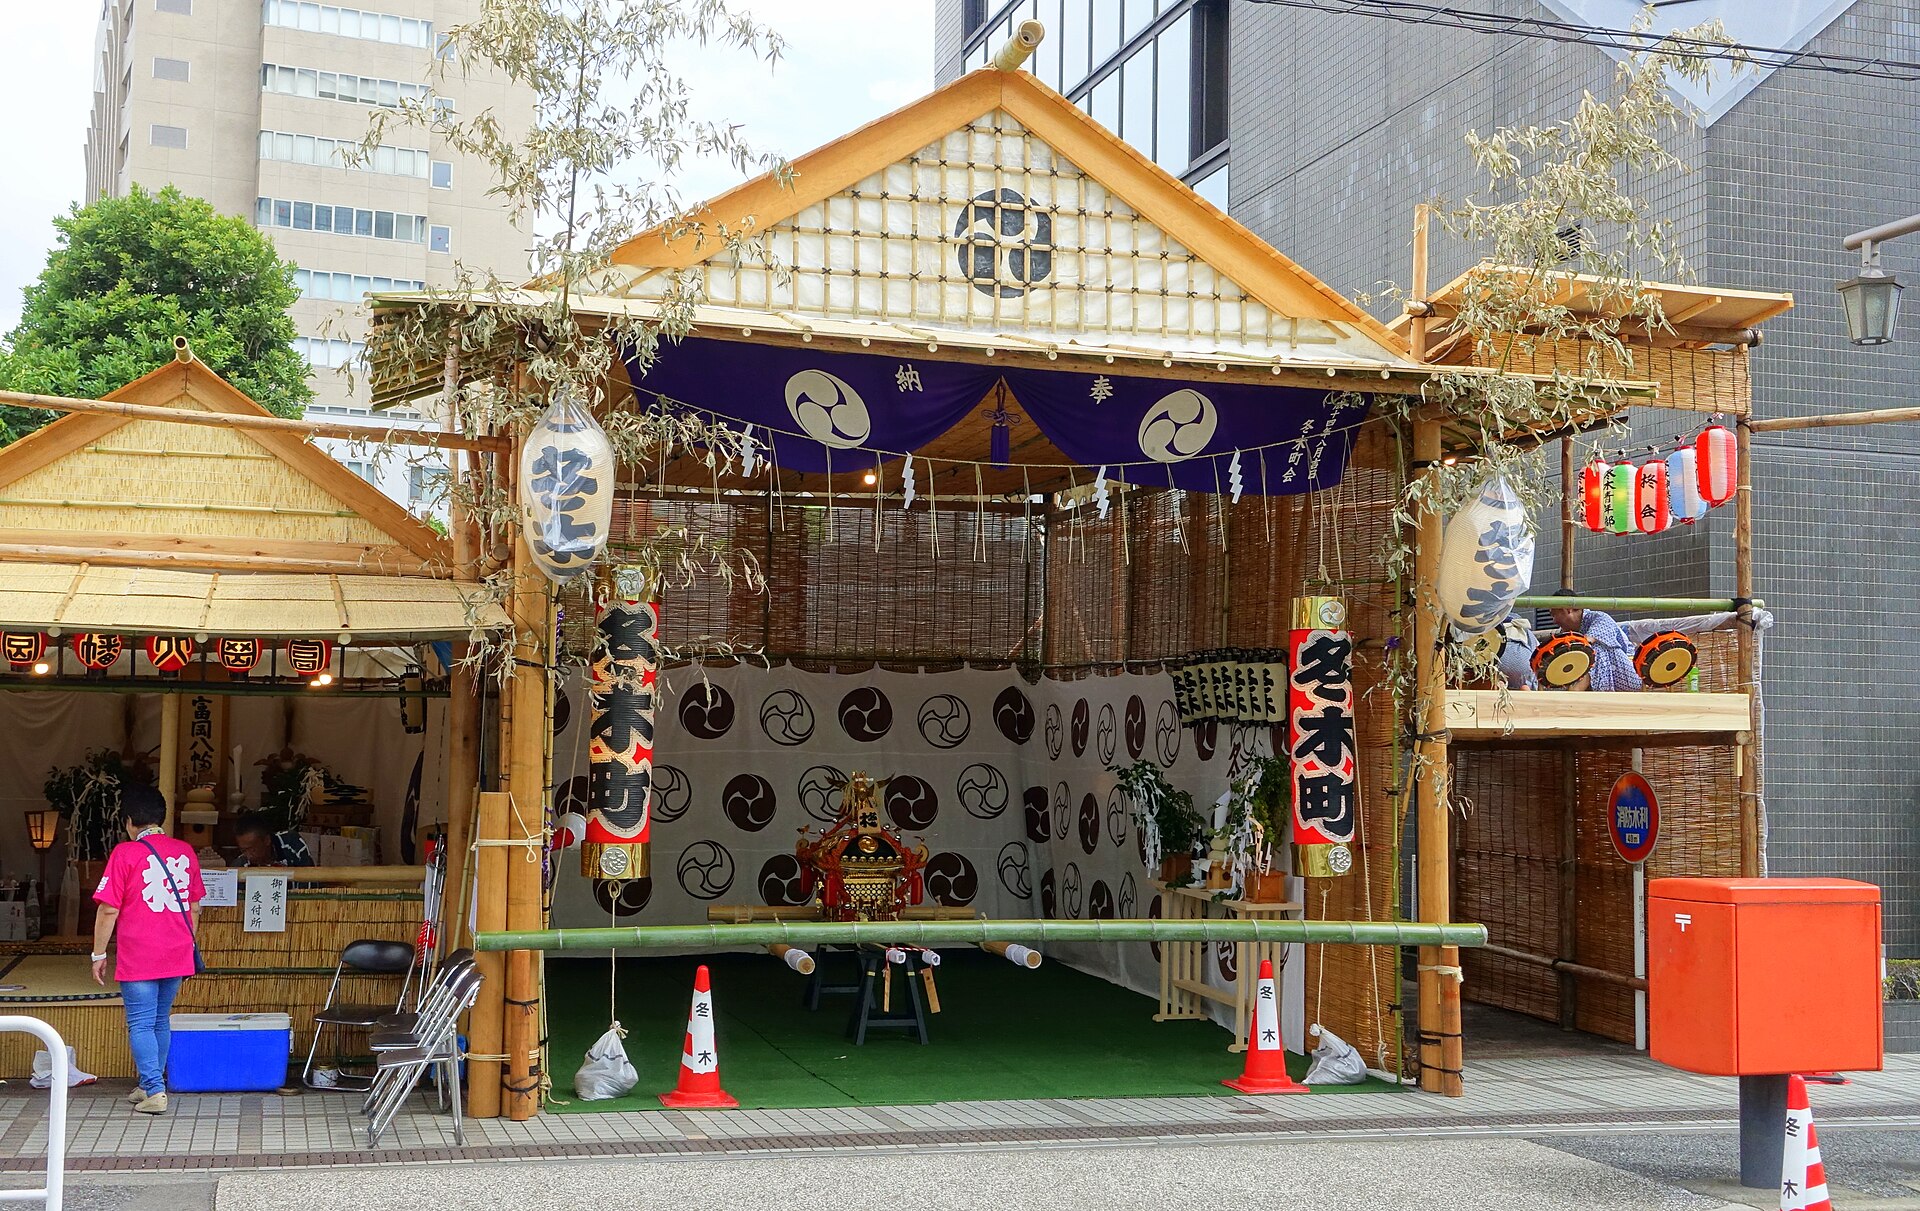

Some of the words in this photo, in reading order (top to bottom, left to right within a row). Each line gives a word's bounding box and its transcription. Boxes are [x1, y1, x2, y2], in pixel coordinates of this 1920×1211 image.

[895, 363, 924, 393] 納
[1089, 375, 1114, 405] 奉
[1282, 419, 1315, 483] 冬木町会
[590, 606, 656, 831] 冬木町
[1293, 637, 1355, 836] 冬木町
[1617, 806, 1648, 829] 消防水利
[250, 892, 262, 928] 受付所
[270, 879, 282, 916] 御寄付
[696, 1002, 712, 1065] 冬木
[1260, 986, 1275, 1043] 冬木
[1783, 1117, 1800, 1199] 冬木
